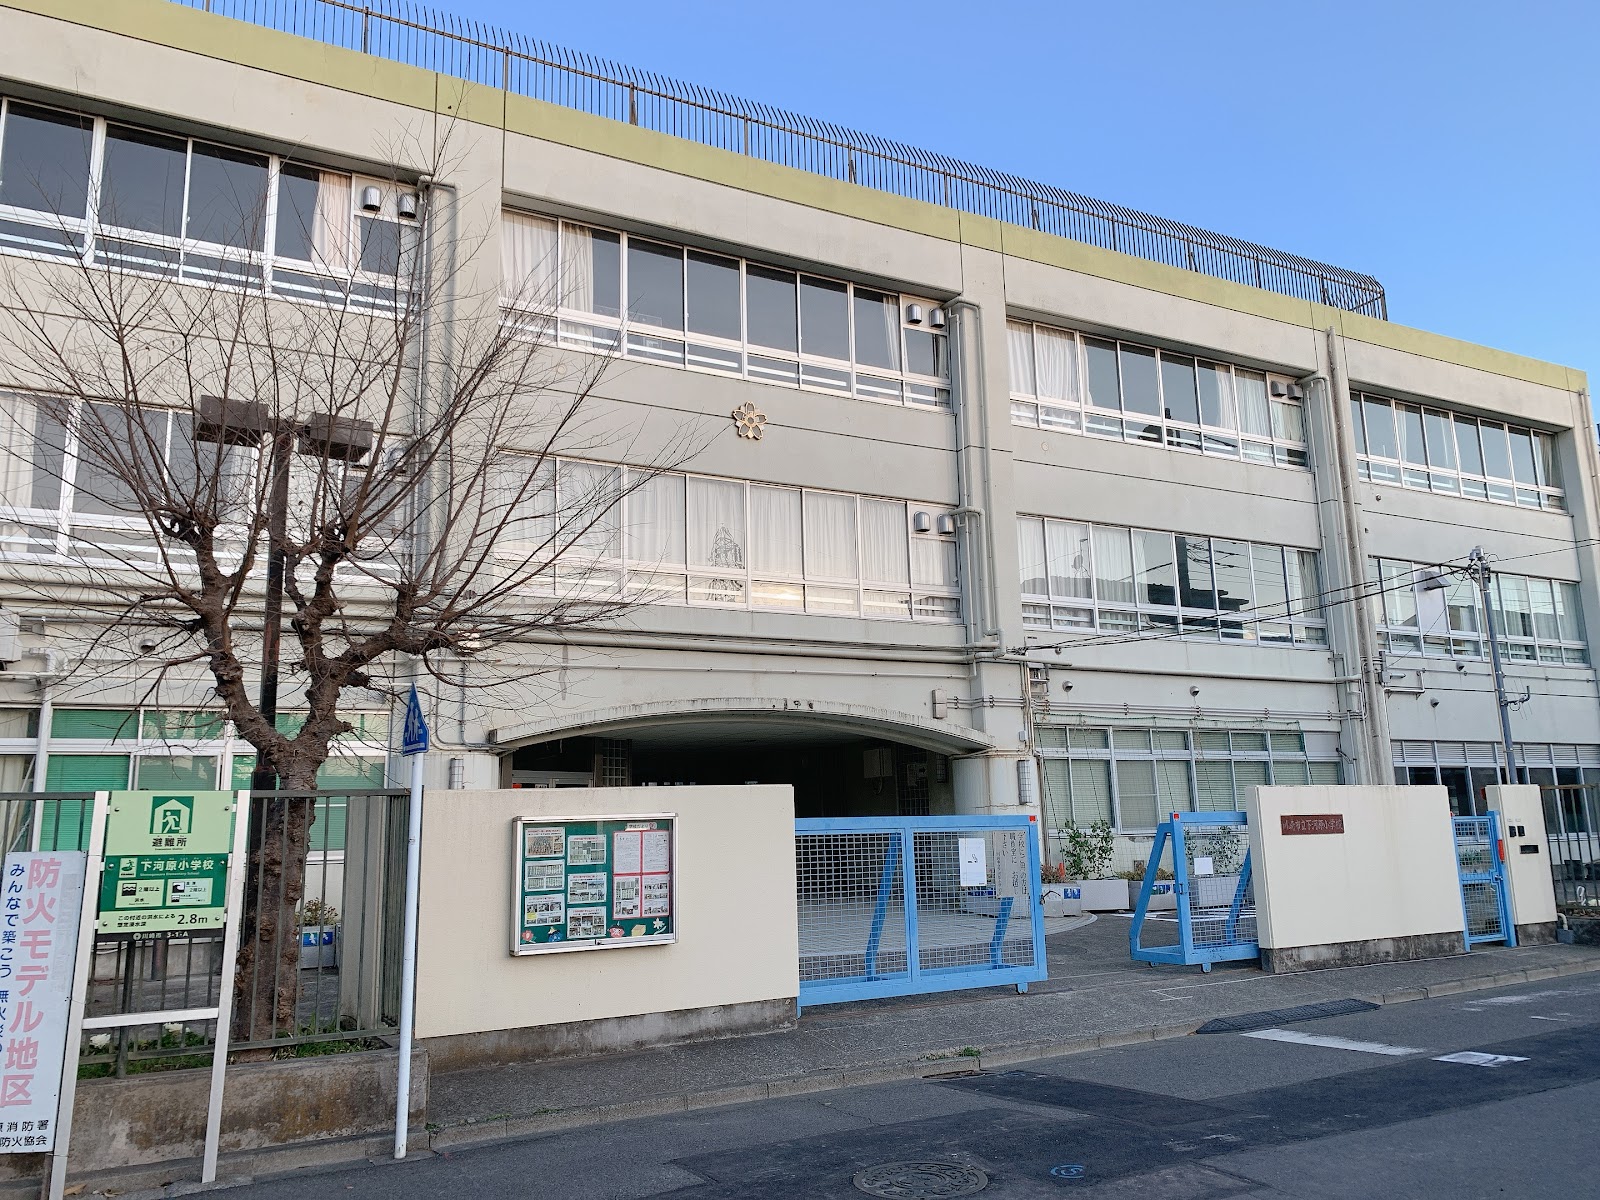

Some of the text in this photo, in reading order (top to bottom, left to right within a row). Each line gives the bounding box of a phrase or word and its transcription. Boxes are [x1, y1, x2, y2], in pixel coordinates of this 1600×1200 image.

[152, 837, 187, 847] 避難所
[140, 860, 214, 872] 下河原小学校
[0, 863, 25, 979] みんなで築こう
[177, 913, 208, 925] 2.8m
[0, 857, 62, 1108] 防火モデル地区
[0, 1134, 47, 1148] 防火協会
